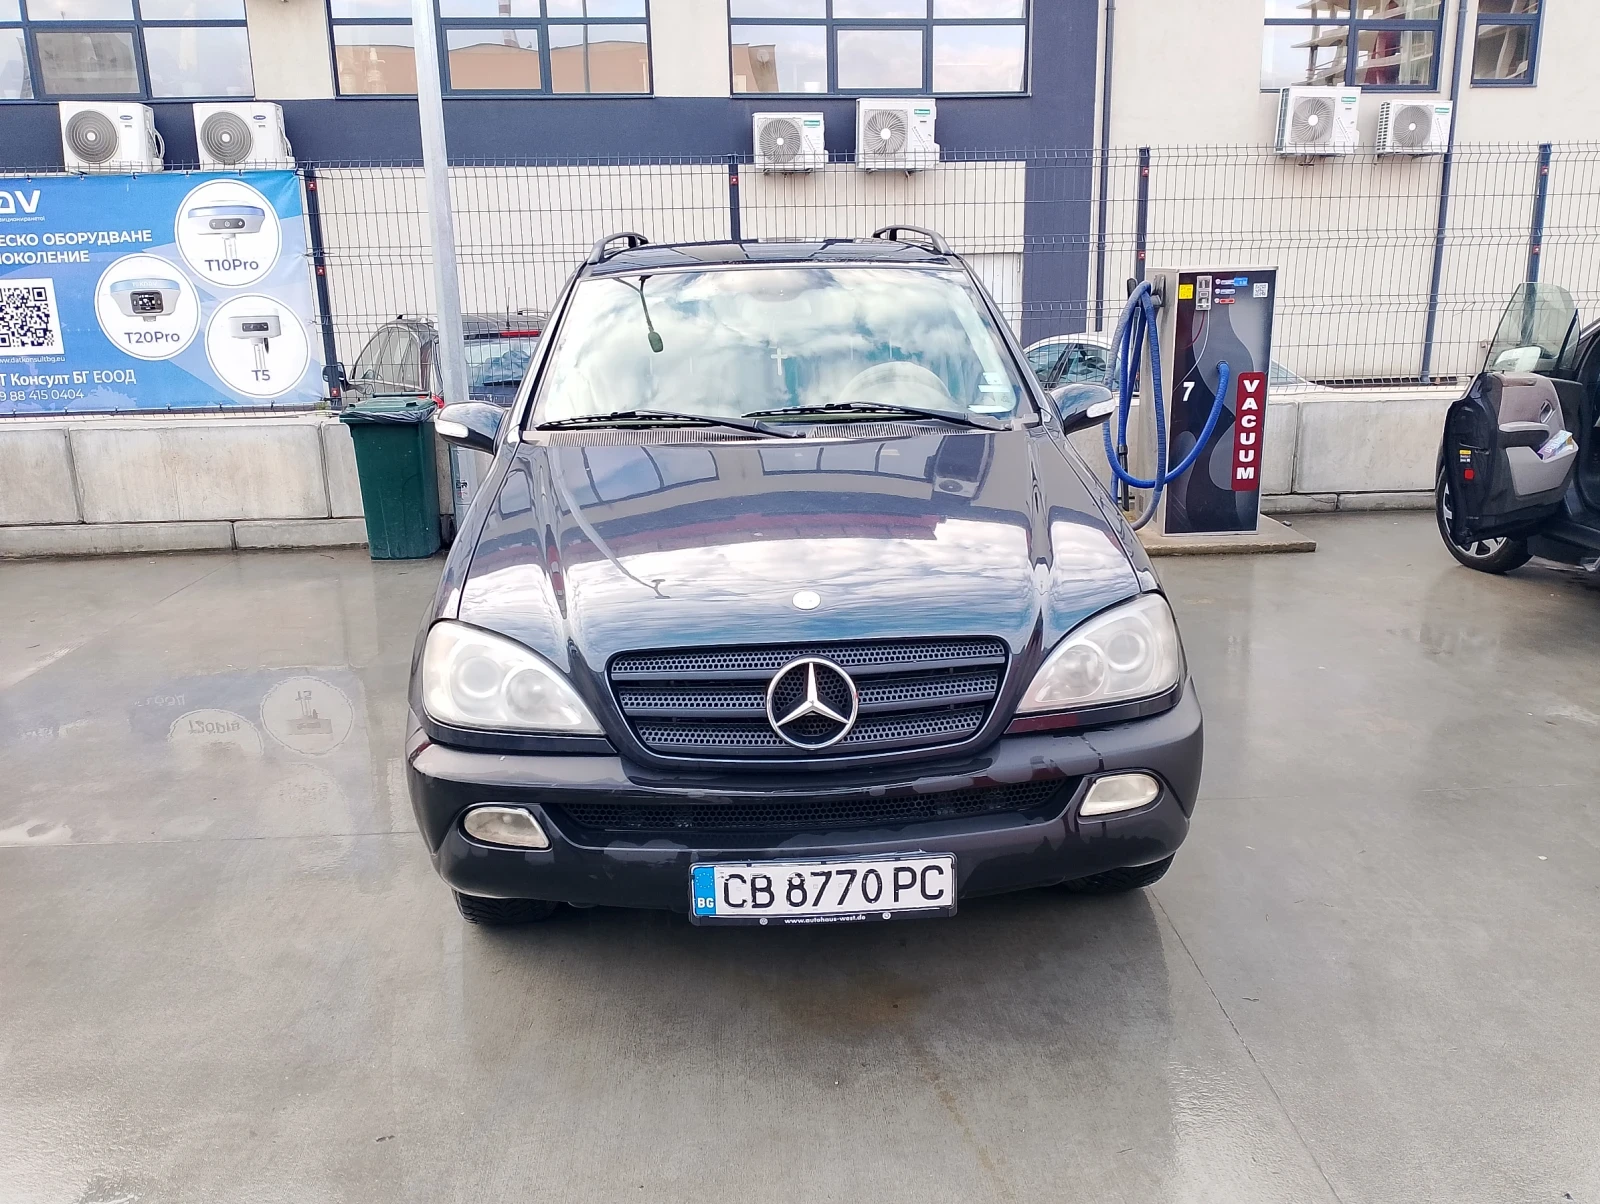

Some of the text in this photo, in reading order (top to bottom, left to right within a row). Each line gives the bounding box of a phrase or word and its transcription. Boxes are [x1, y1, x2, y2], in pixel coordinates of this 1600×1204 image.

[42, 230, 153, 246] ОБОРУДВАНЕ
[204, 258, 259, 272] T10Pro
[124, 331, 180, 344] T20Pro
[10, 372, 70, 388] Консулт
[73, 370, 90, 384] БГ
[93, 369, 137, 385] ЕООД
[251, 369, 271, 382] T5
[9, 390, 26, 401] 88
[29, 389, 49, 400] 415
[51, 388, 85, 400] 0404
[1182, 381, 1194, 402] 7
[1236, 379, 1260, 480] VACUUM
[723, 864, 944, 909] CB 8770 PC
[697, 897, 714, 908] BG
